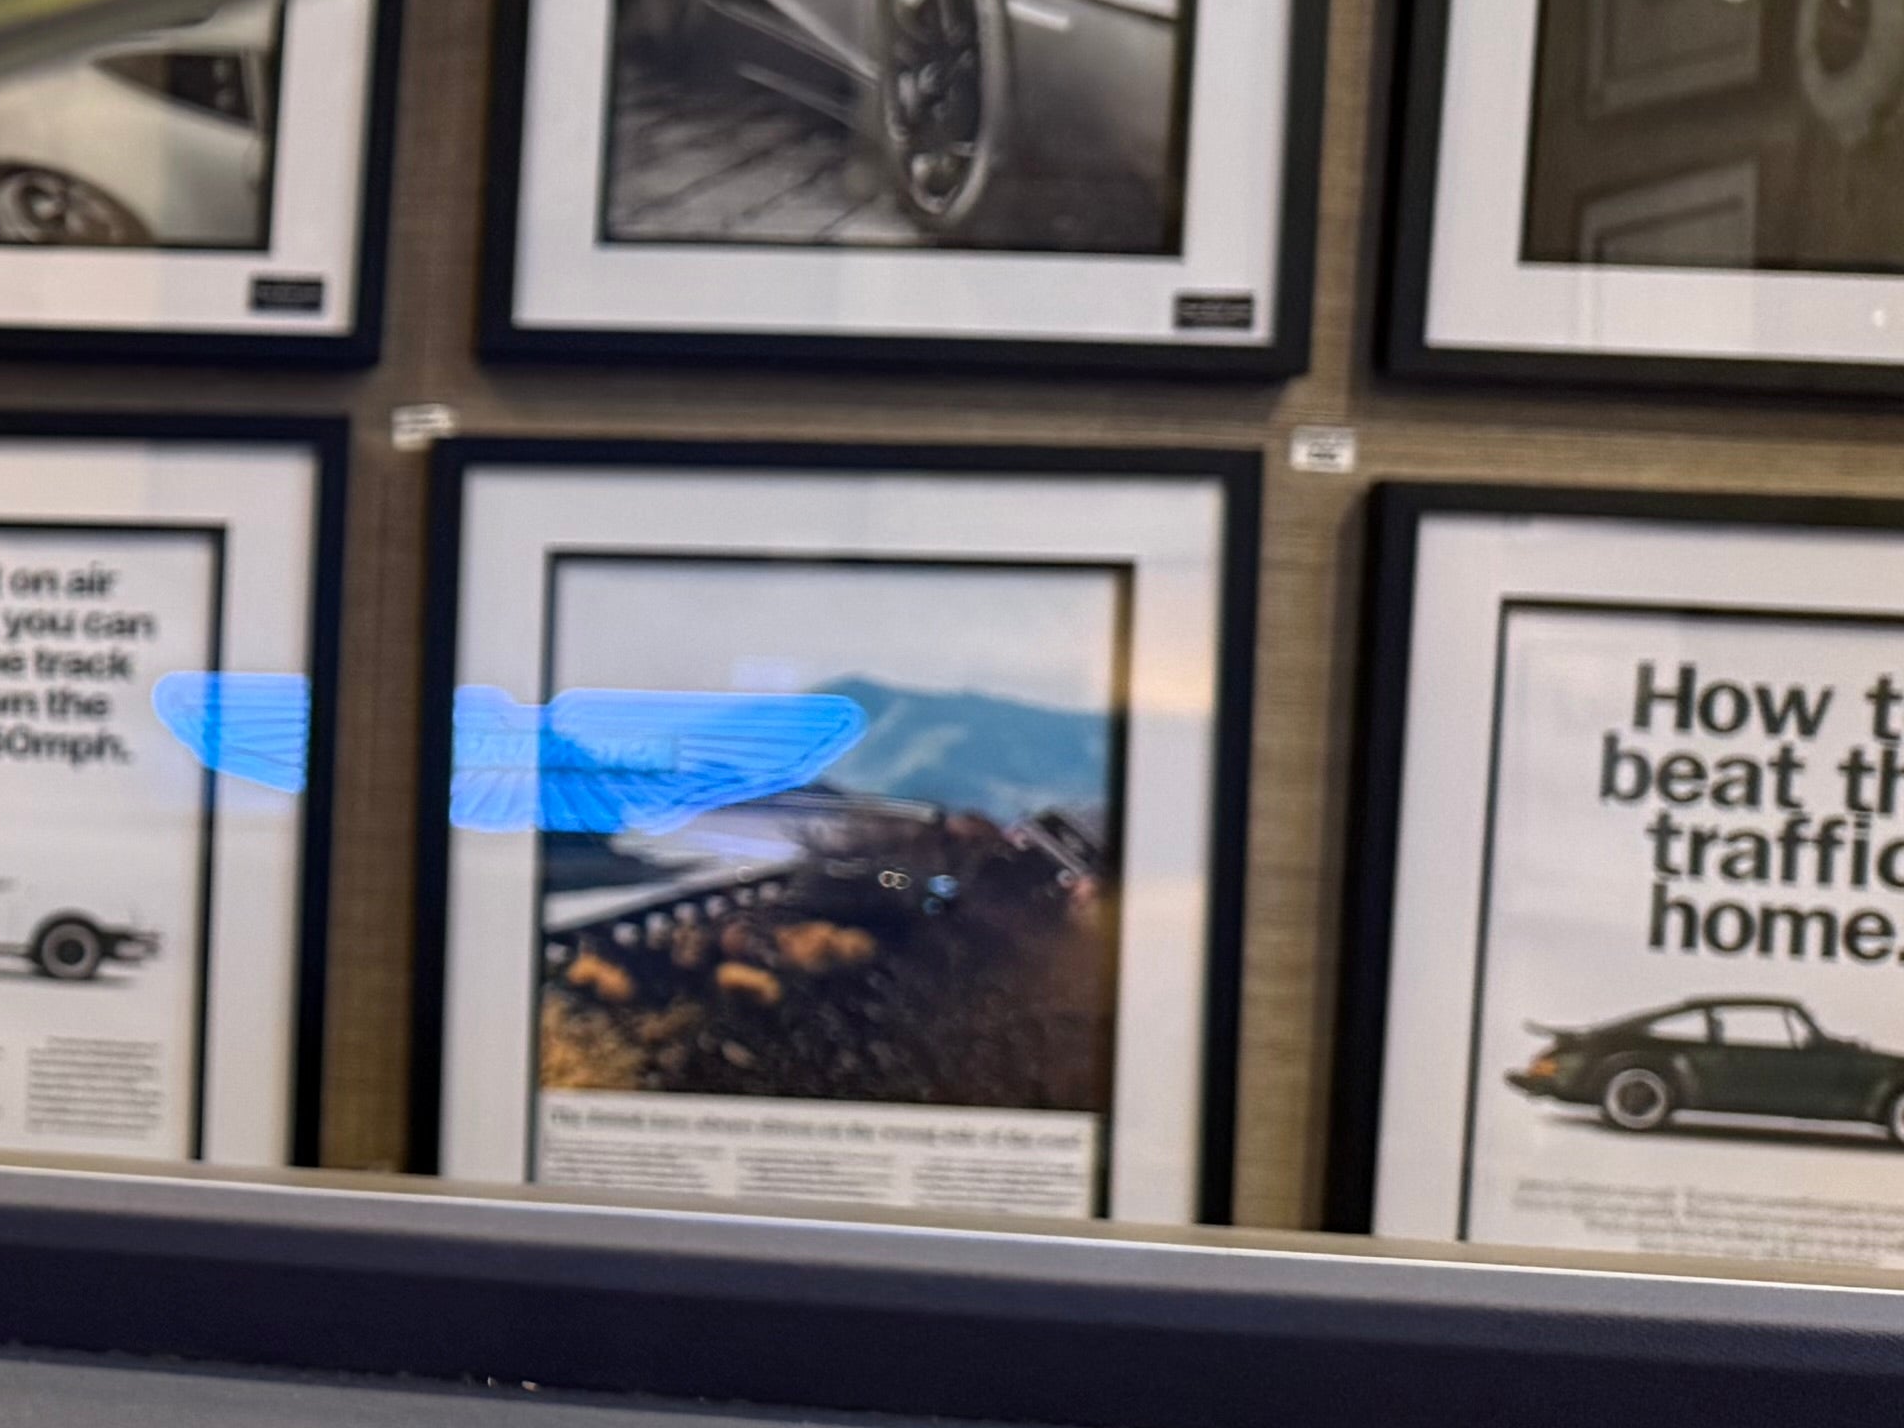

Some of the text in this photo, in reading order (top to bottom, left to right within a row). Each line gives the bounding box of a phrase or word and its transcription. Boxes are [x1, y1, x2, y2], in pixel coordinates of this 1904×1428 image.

[9, 568, 59, 593] on
[65, 559, 116, 596] air
[2, 608, 77, 639] you
[81, 612, 157, 638] can
[34, 646, 134, 677] track
[45, 687, 111, 718] the
[1633, 659, 1835, 737] How
[1600, 729, 1904, 818] beat th
[1646, 808, 1904, 890] traffic
